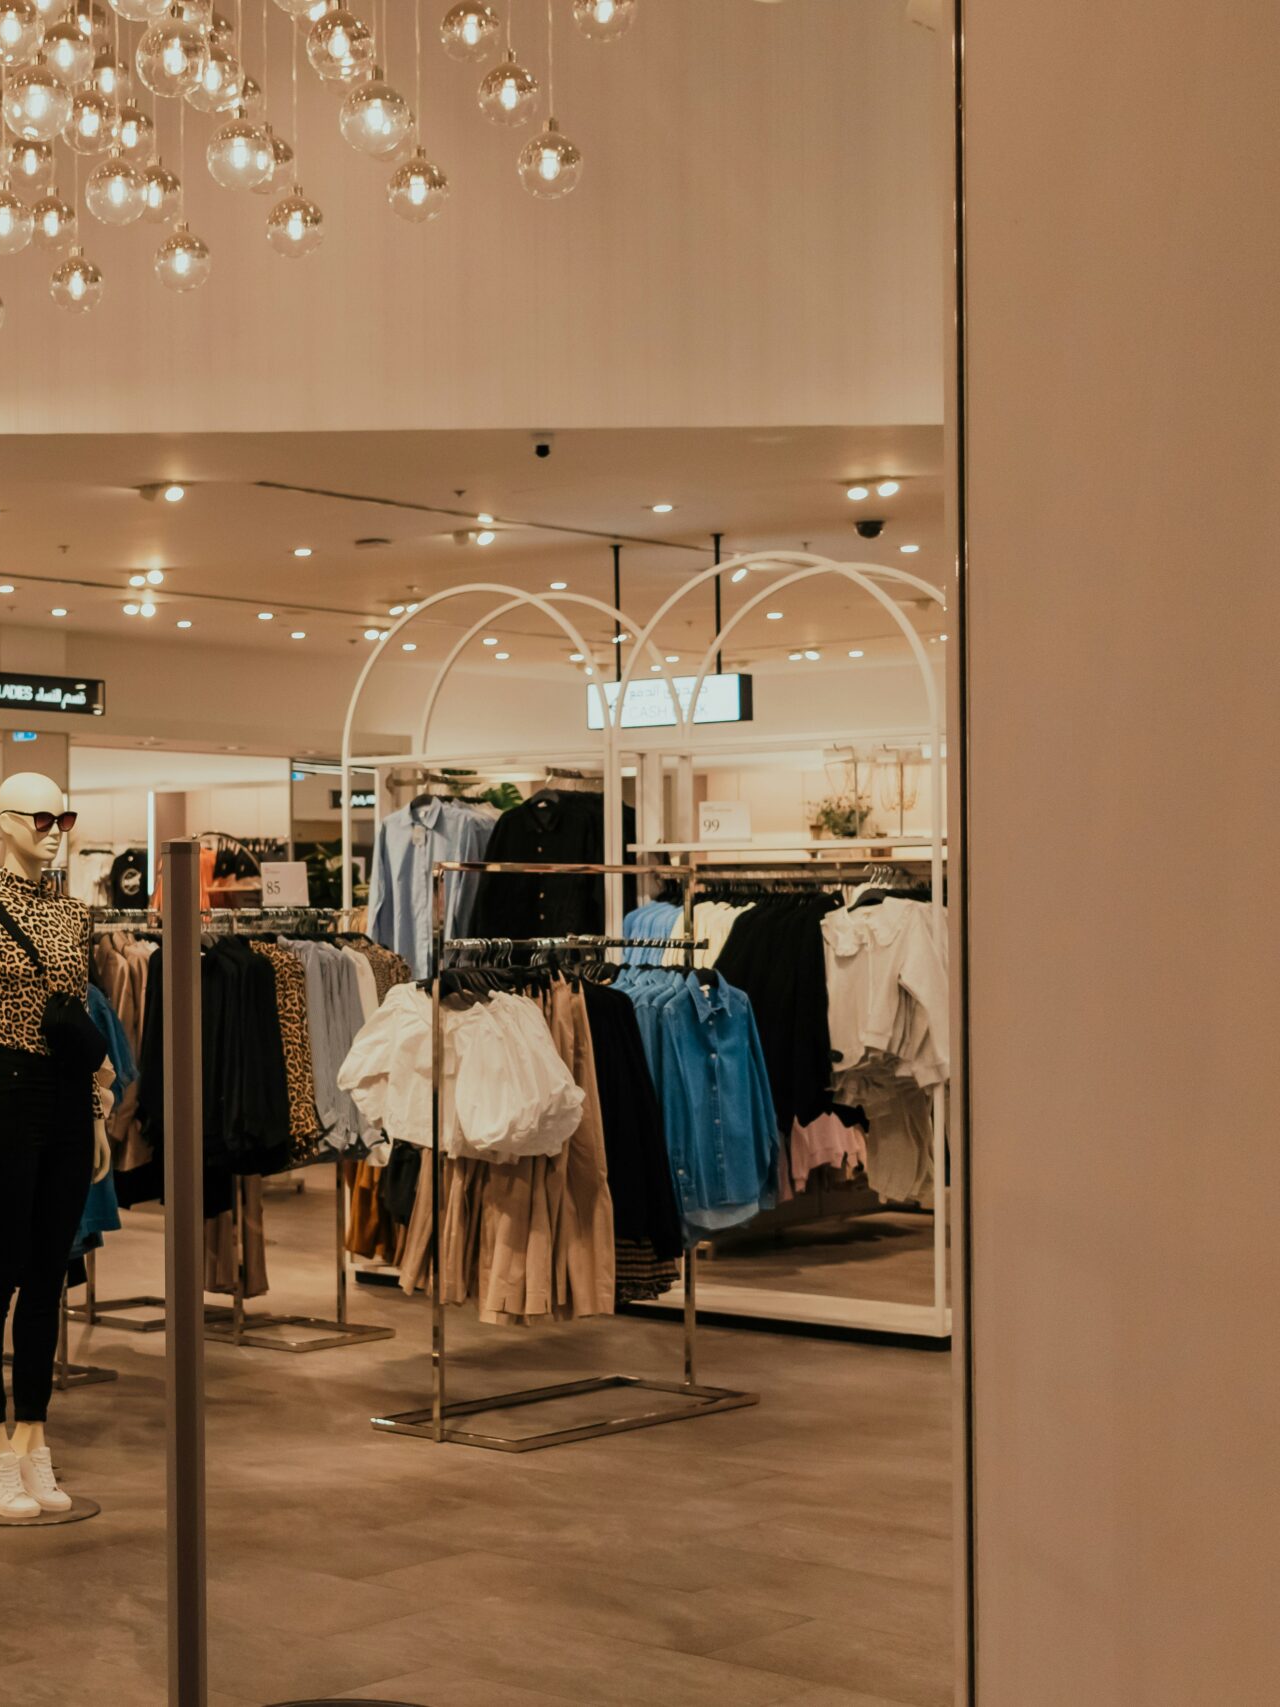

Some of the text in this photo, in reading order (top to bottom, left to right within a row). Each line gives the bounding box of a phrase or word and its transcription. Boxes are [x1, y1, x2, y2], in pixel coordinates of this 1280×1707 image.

[629, 704, 667, 720] CASH
[703, 819, 720, 832] 99
[266, 880, 281, 895] 85
